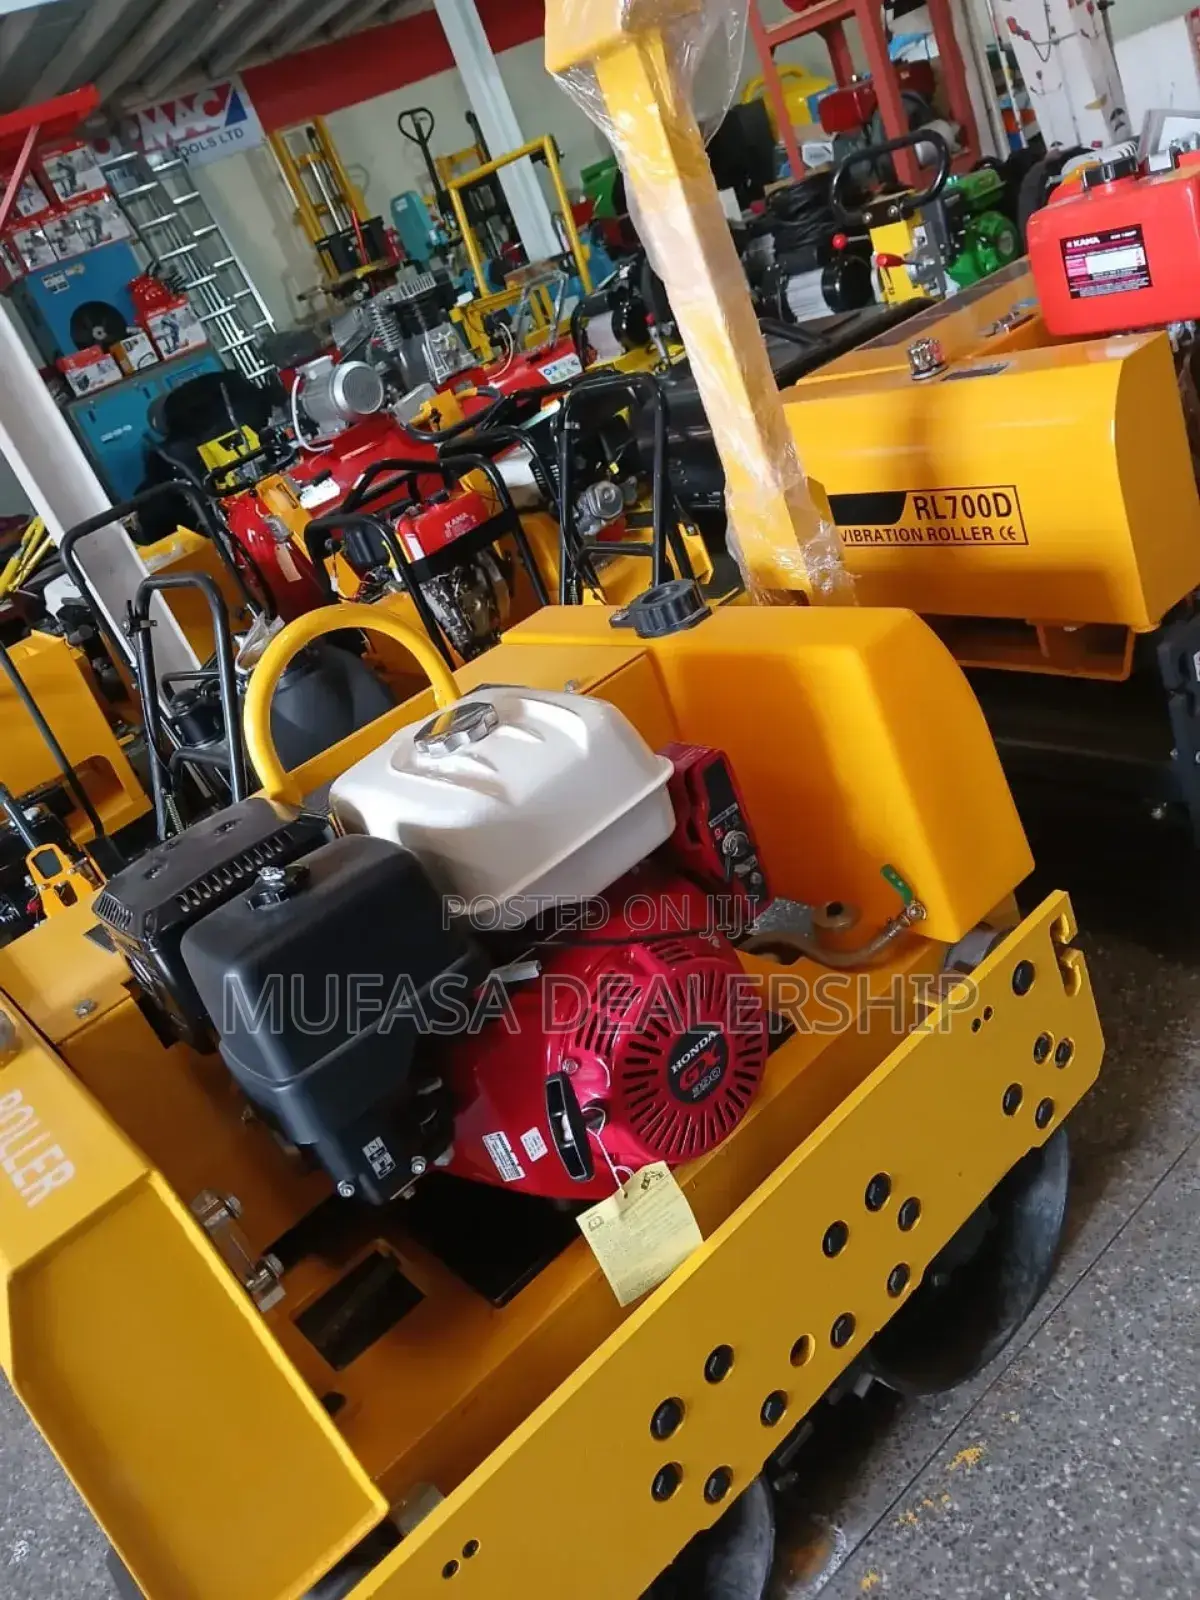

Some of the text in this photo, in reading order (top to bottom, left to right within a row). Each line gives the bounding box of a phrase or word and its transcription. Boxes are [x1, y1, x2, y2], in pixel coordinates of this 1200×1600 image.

[179, 128, 245, 159] OOLS LTD
[912, 493, 1013, 520] RL700D
[841, 527, 923, 543] VIBRATION
[926, 526, 995, 541] ROLLER
[671, 1031, 718, 1074] HONDA
[679, 1044, 720, 1091] GX
